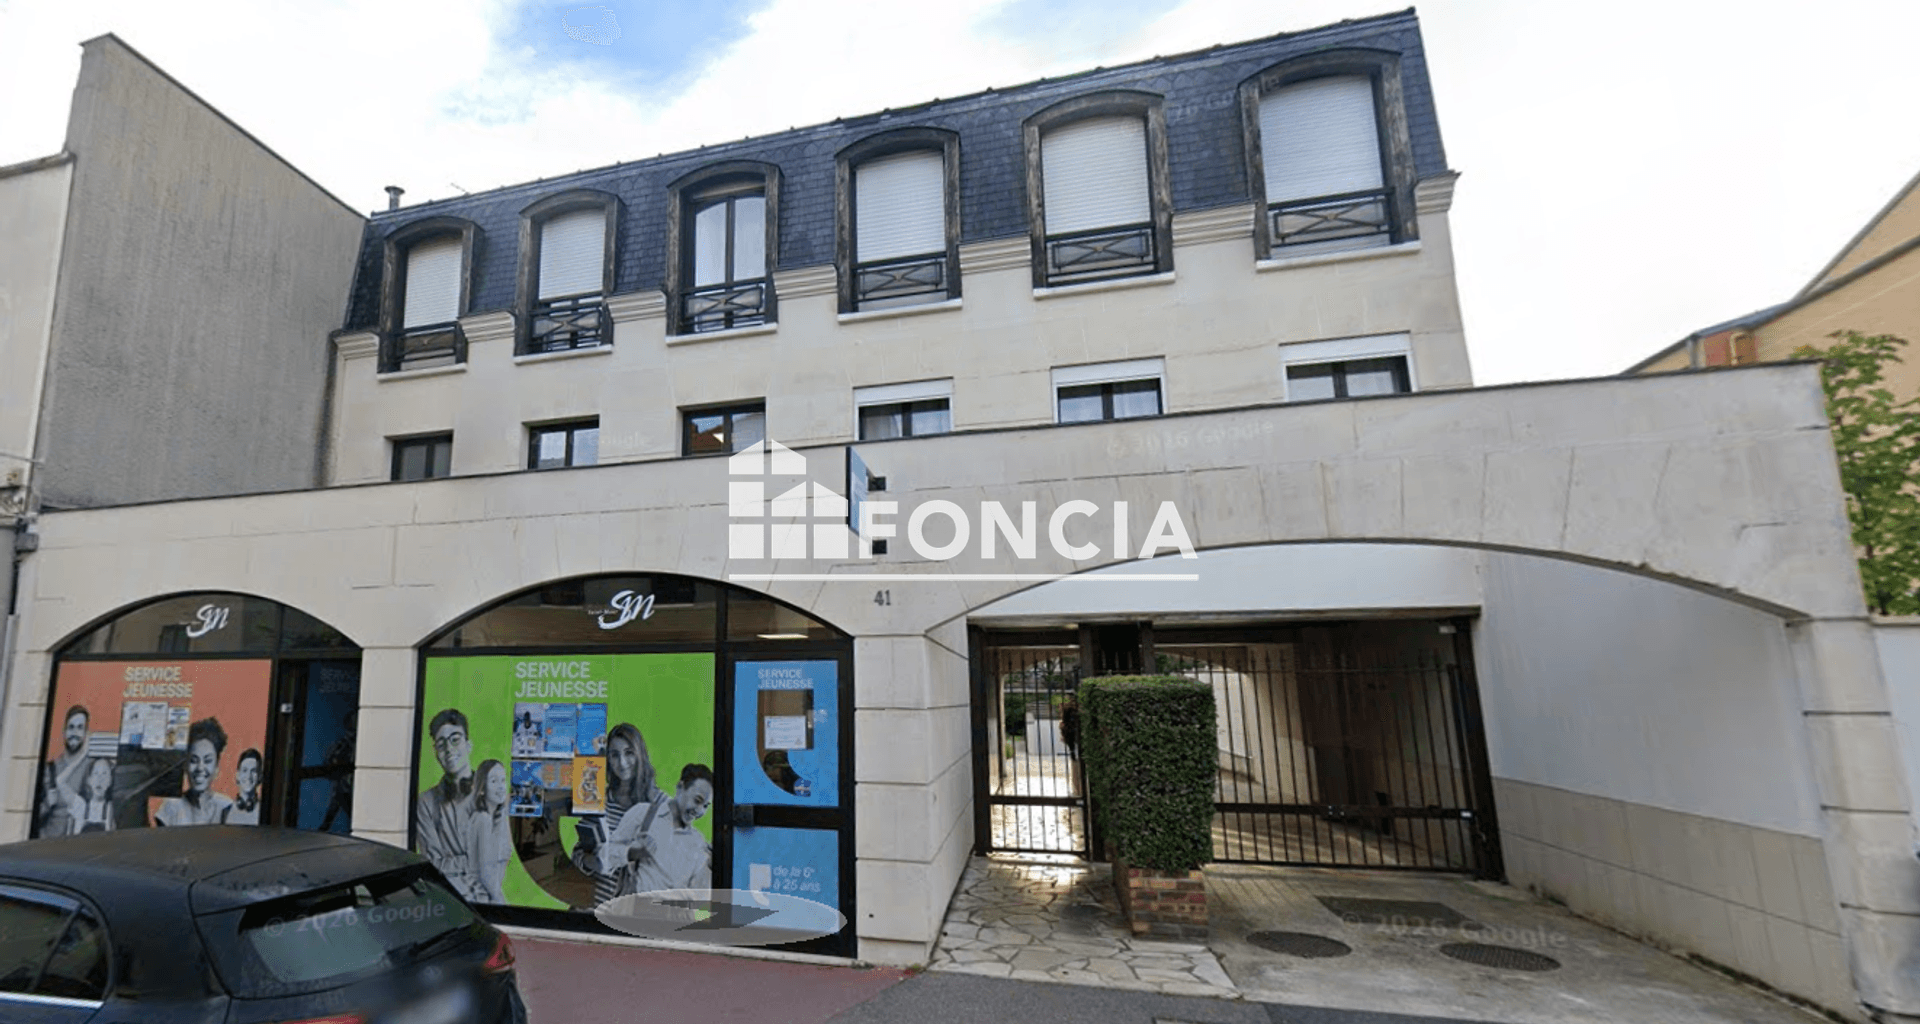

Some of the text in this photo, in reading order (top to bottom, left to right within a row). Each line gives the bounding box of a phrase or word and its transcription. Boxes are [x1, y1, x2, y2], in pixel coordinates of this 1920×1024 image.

[873, 589, 892, 607] 41
[123, 666, 182, 682] SERVICE
[515, 661, 591, 679] SERVICE
[758, 668, 803, 679] SERVICE
[123, 683, 194, 698] JEUNESSE
[514, 680, 609, 698] JEUNESSE
[758, 678, 814, 689] JEUNESSE
[773, 865, 789, 877] de
[790, 866, 802, 878] la
[783, 878, 799, 891] 25
[800, 881, 821, 893] ans
